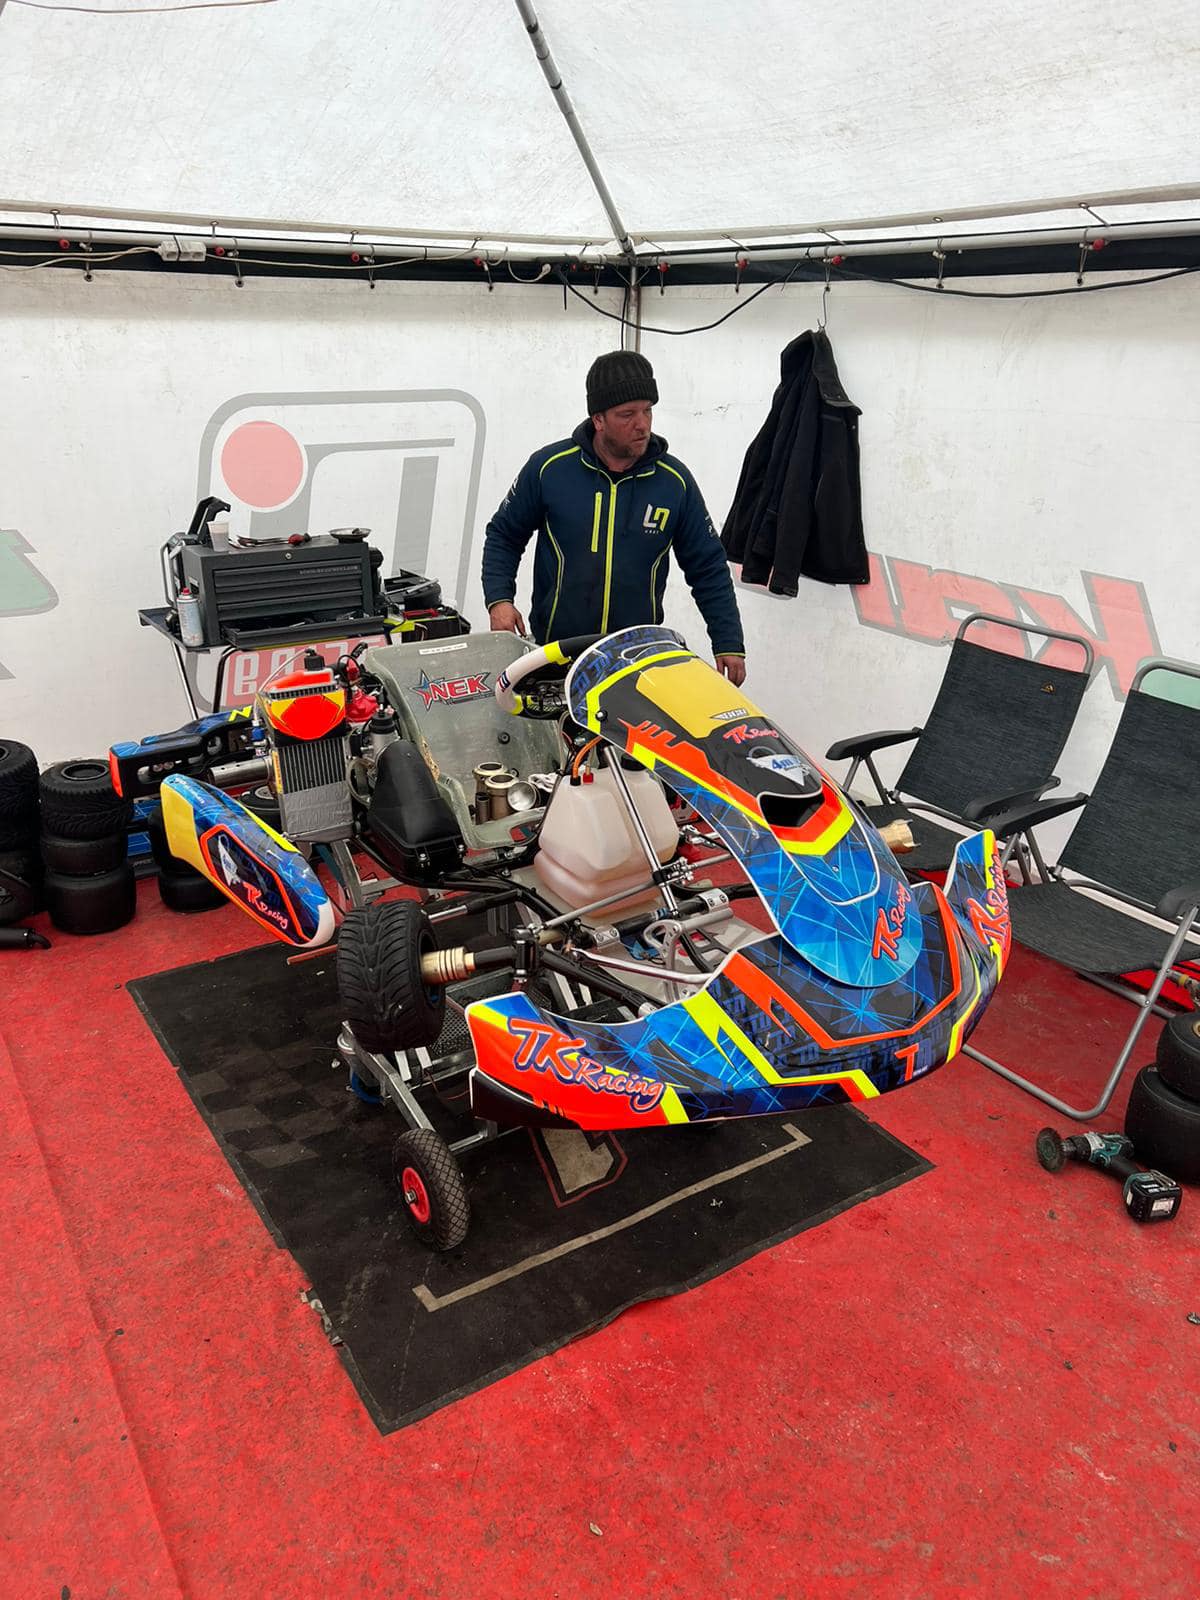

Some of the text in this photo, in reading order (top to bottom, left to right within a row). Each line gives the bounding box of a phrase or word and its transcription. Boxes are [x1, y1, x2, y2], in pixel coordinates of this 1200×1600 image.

[429, 673, 491, 701] NEK
[723, 724, 754, 744] TK
[242, 881, 289, 930] TK Racing
[872, 908, 902, 960] TK
[508, 1017, 665, 1113] TK Racing
